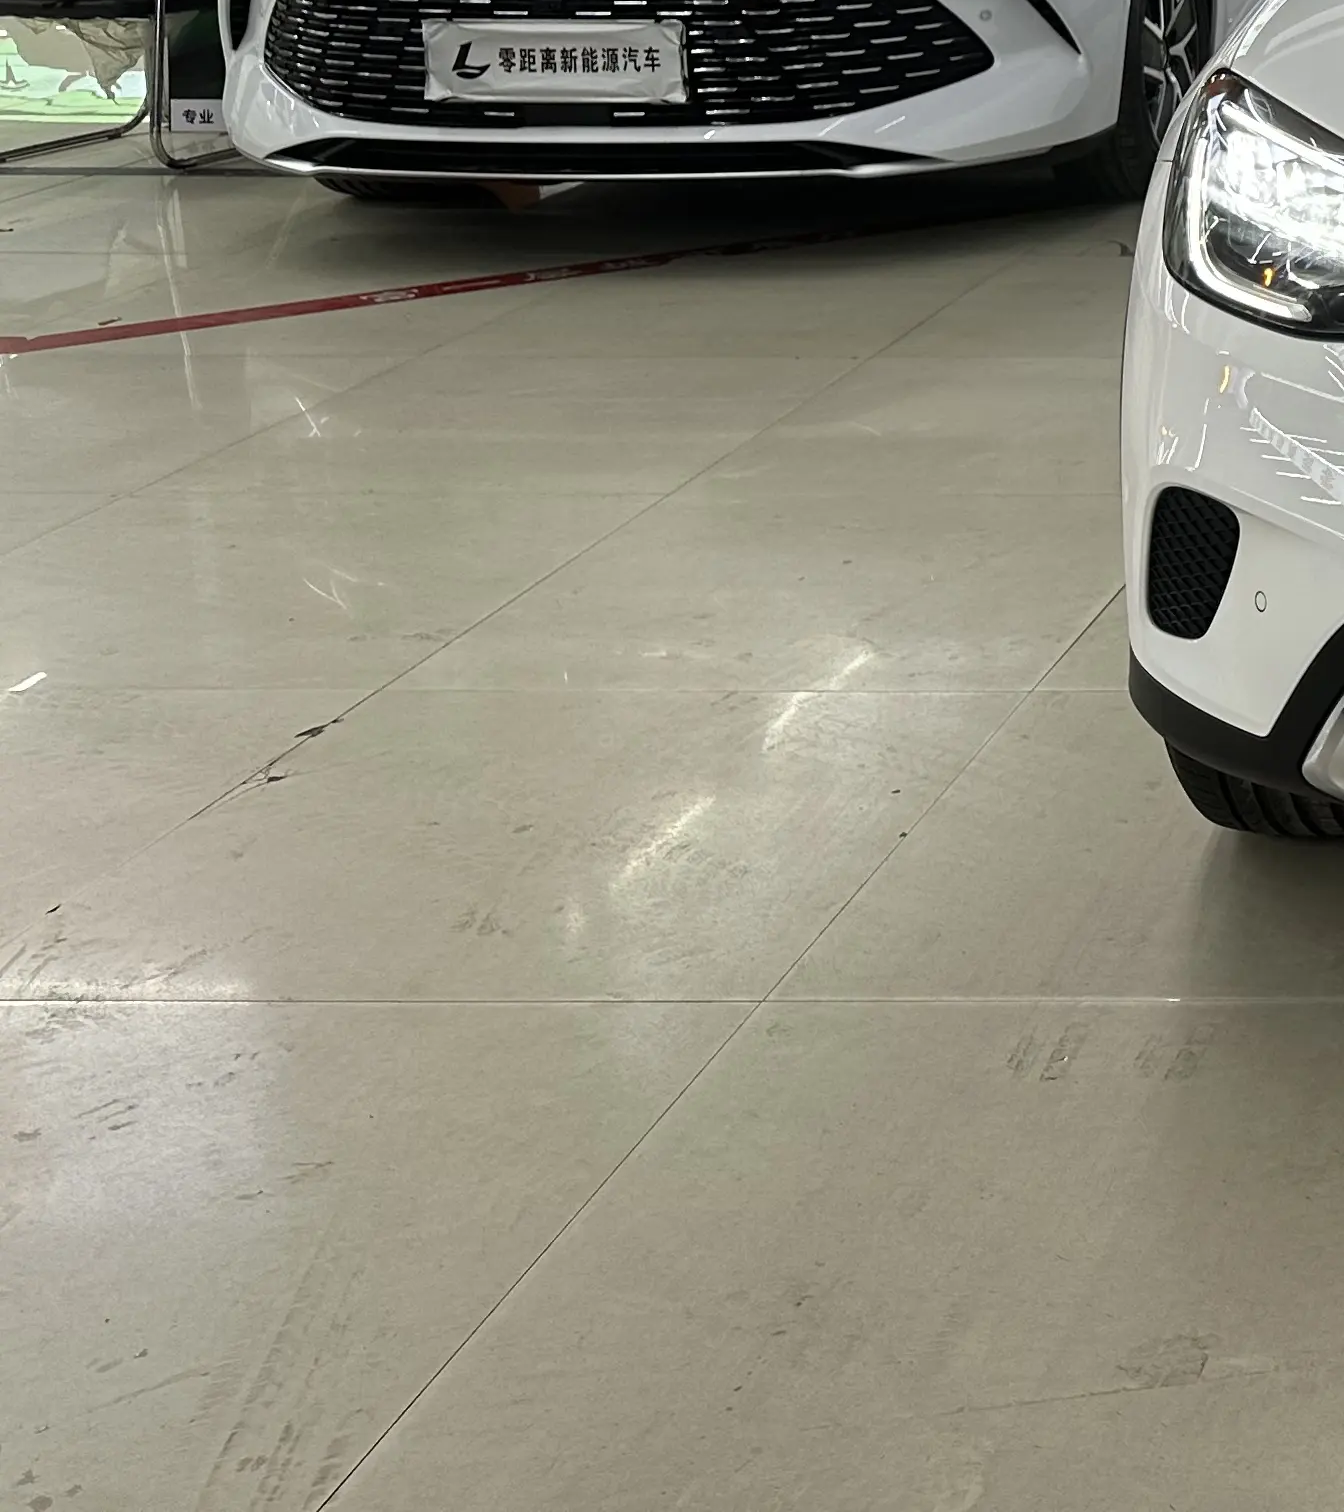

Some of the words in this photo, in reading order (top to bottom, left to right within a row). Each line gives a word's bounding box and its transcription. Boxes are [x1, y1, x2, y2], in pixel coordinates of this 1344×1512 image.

[498, 47, 661, 73] 零距离新能源汽车
